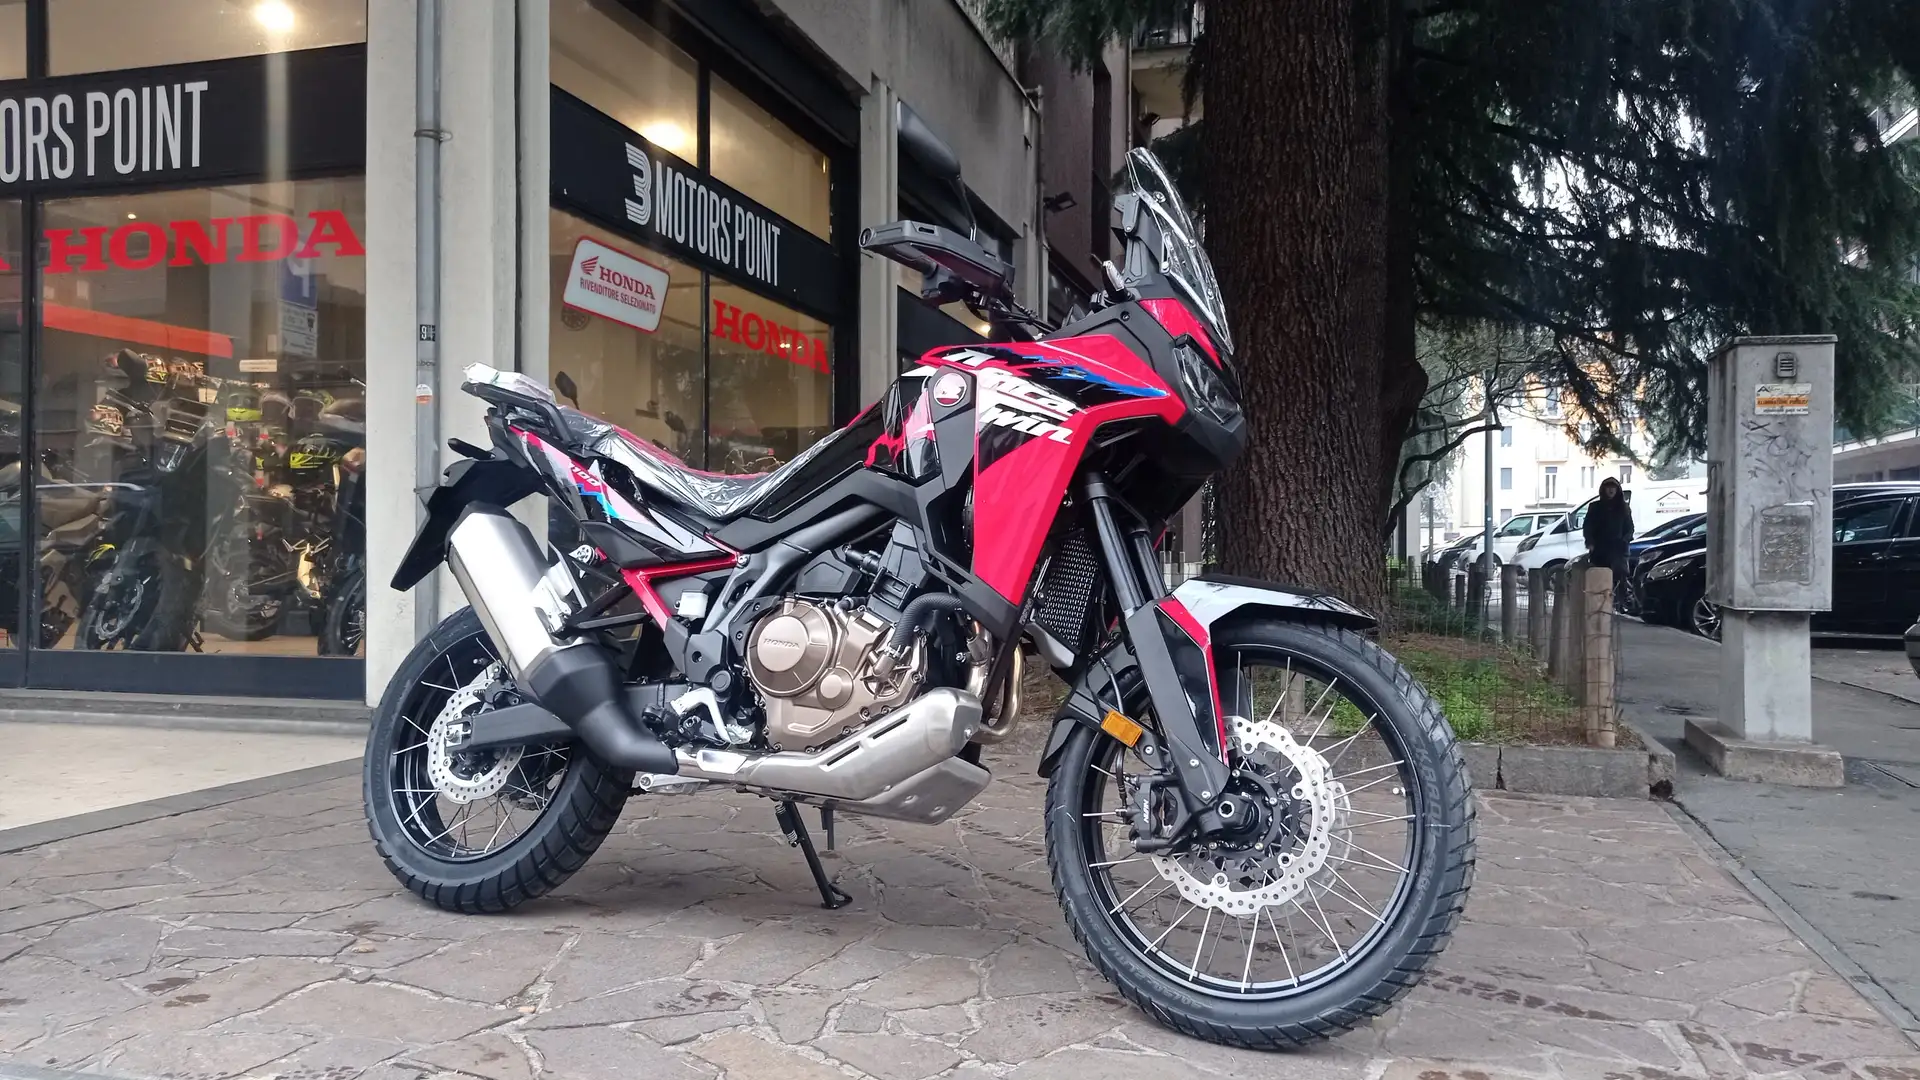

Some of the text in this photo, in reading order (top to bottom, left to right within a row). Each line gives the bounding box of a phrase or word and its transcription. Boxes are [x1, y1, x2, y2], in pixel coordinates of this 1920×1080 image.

[86, 80, 209, 177] POINT
[44, 211, 366, 275] HONDA
[625, 142, 781, 287] 3 MOTORS POINT
[580, 277, 656, 315] RIVENDITORE SELEZIONATO
[599, 265, 656, 301] HONDA
[712, 298, 831, 375] HONDA
[763, 638, 800, 650] HONDA
